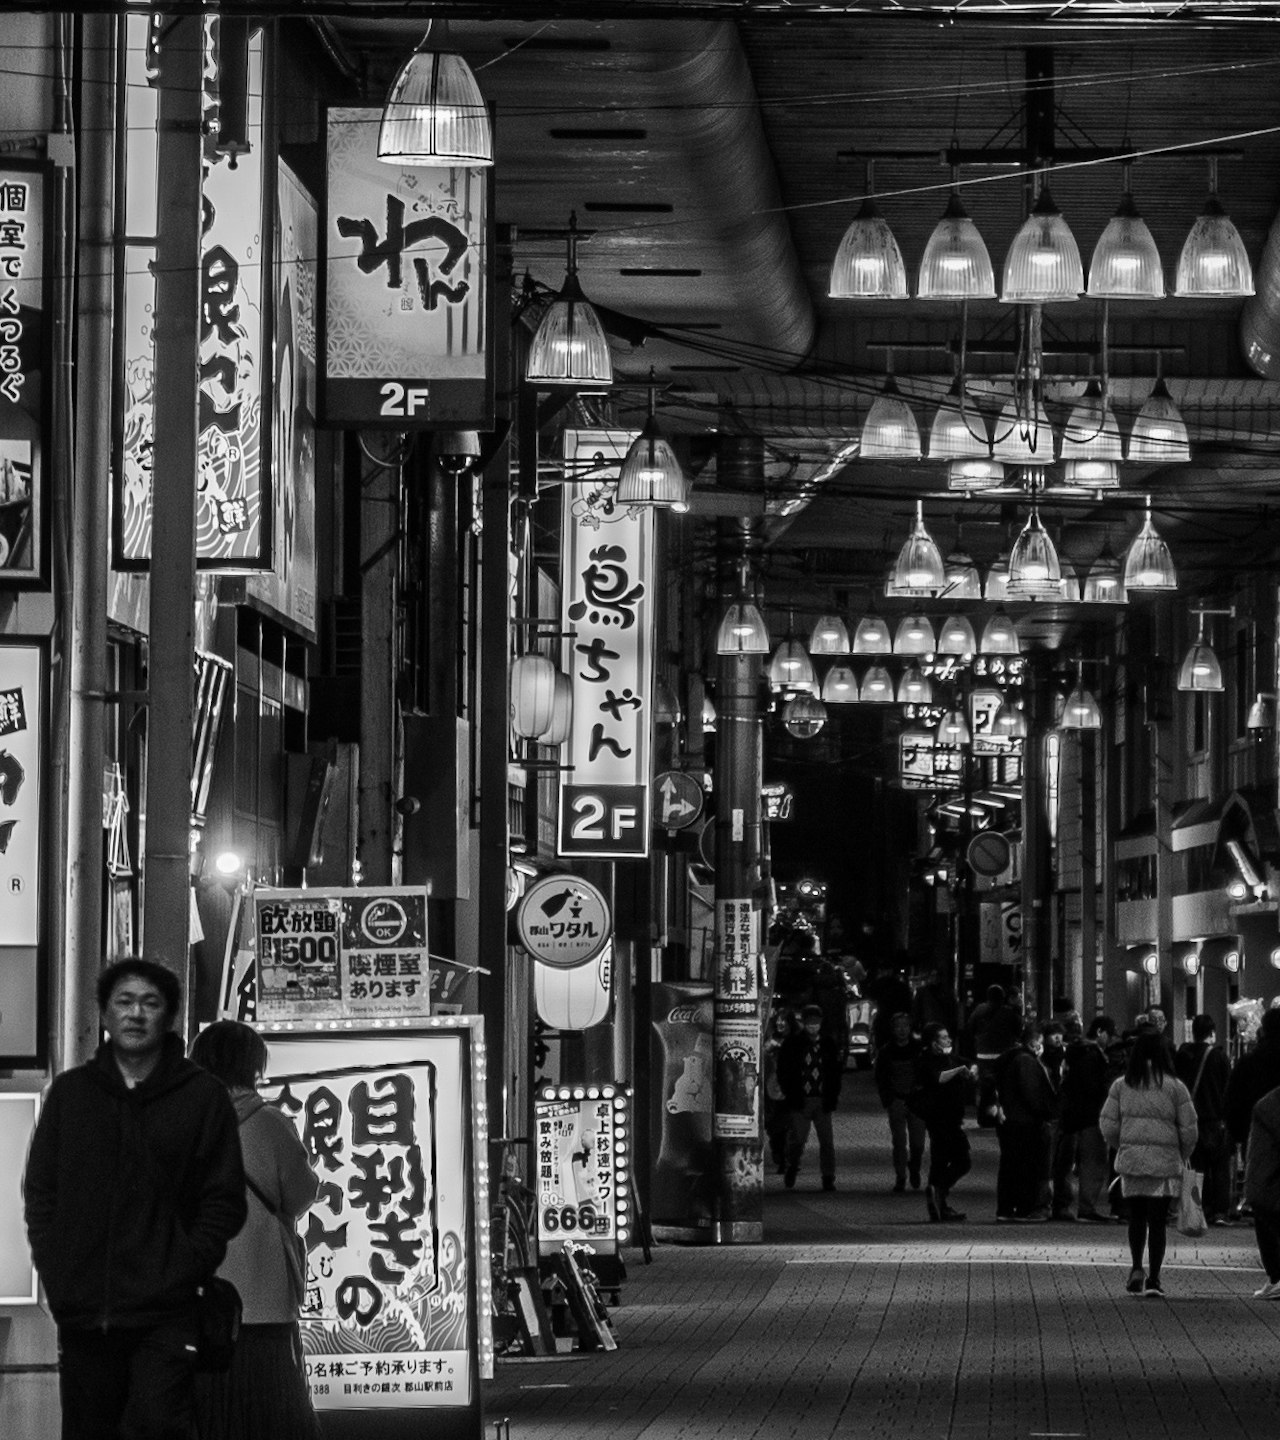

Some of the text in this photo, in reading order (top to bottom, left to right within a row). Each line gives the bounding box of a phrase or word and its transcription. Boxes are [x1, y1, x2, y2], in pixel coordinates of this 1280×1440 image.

[379, 381, 429, 417] 2F
[571, 794, 637, 841] 2F
[348, 953, 422, 977] 喫煙室
[349, 978, 421, 1000] あります
[595, 1102, 612, 1214] 卓上秒速サワー
[405, 1380, 454, 1393] 郡山駅前店
